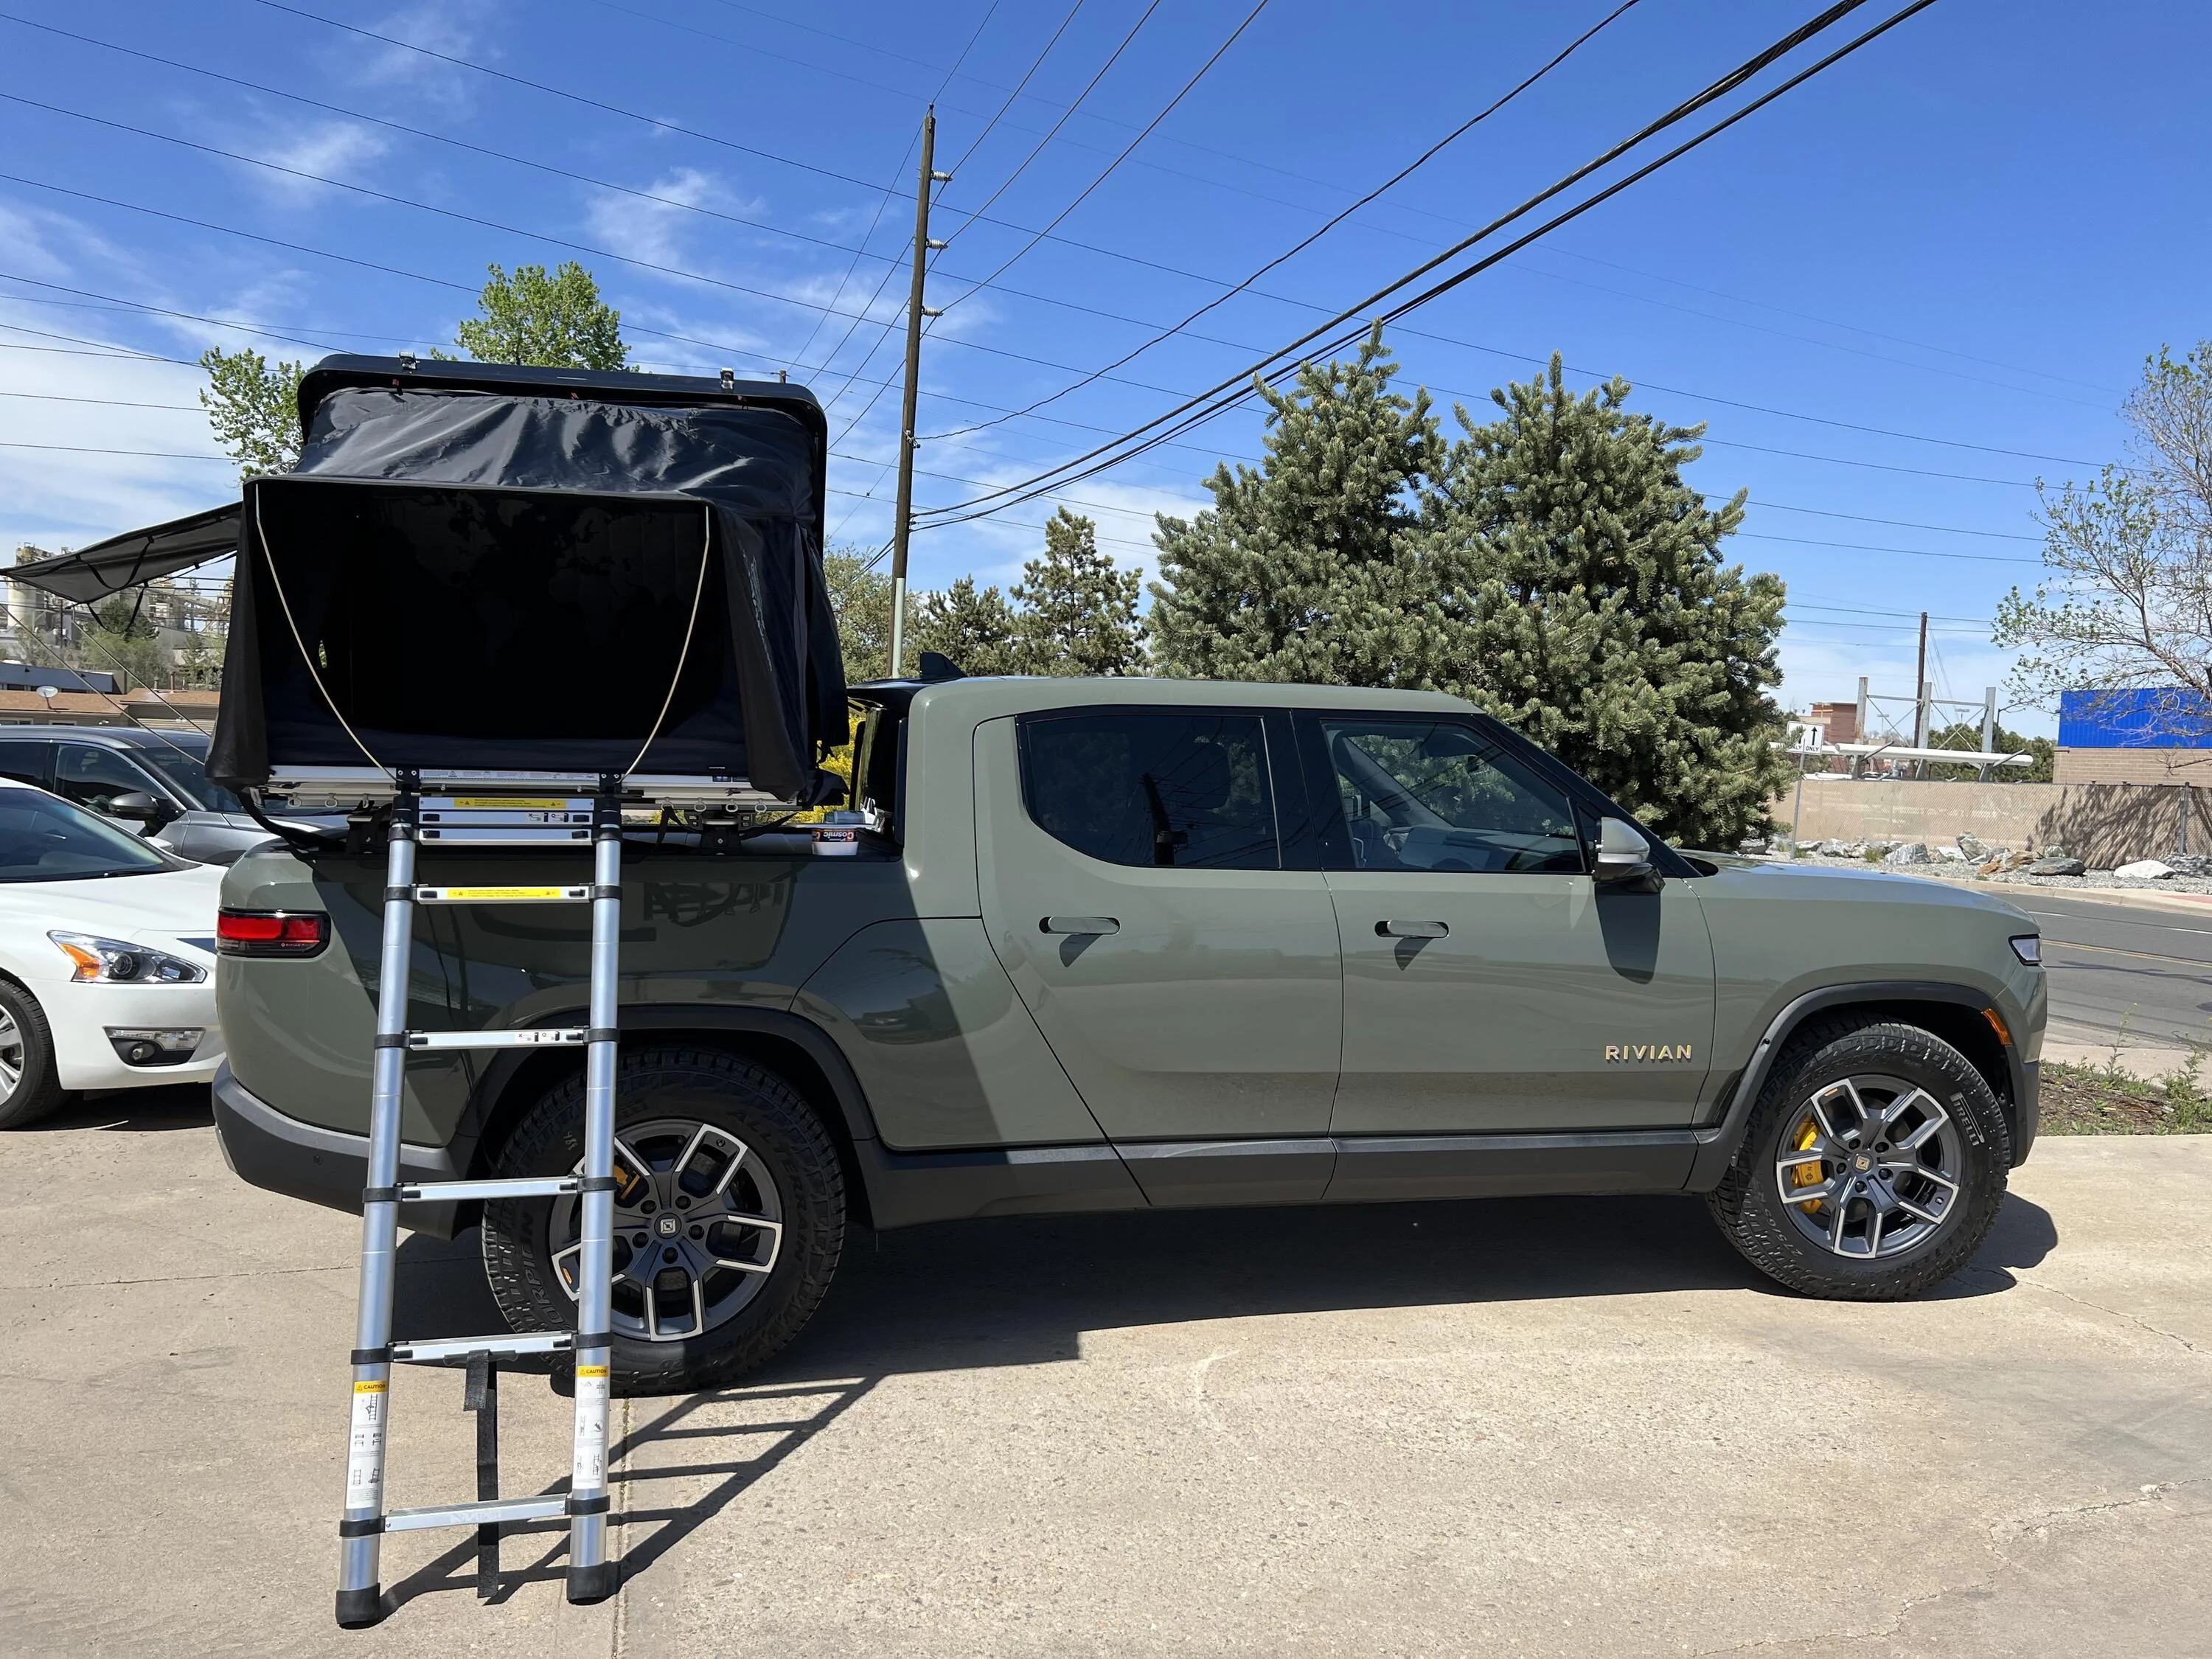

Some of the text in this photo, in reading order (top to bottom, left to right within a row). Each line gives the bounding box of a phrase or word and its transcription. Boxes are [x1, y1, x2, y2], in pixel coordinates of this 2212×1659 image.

[823, 830, 855, 840] Cosmic
[1605, 1044, 1692, 1060] RIVIAN
[1950, 1091, 1985, 1146] PIRELLI
[773, 1139, 808, 1262] TERRAIN
[519, 1212, 578, 1330] ORPION
